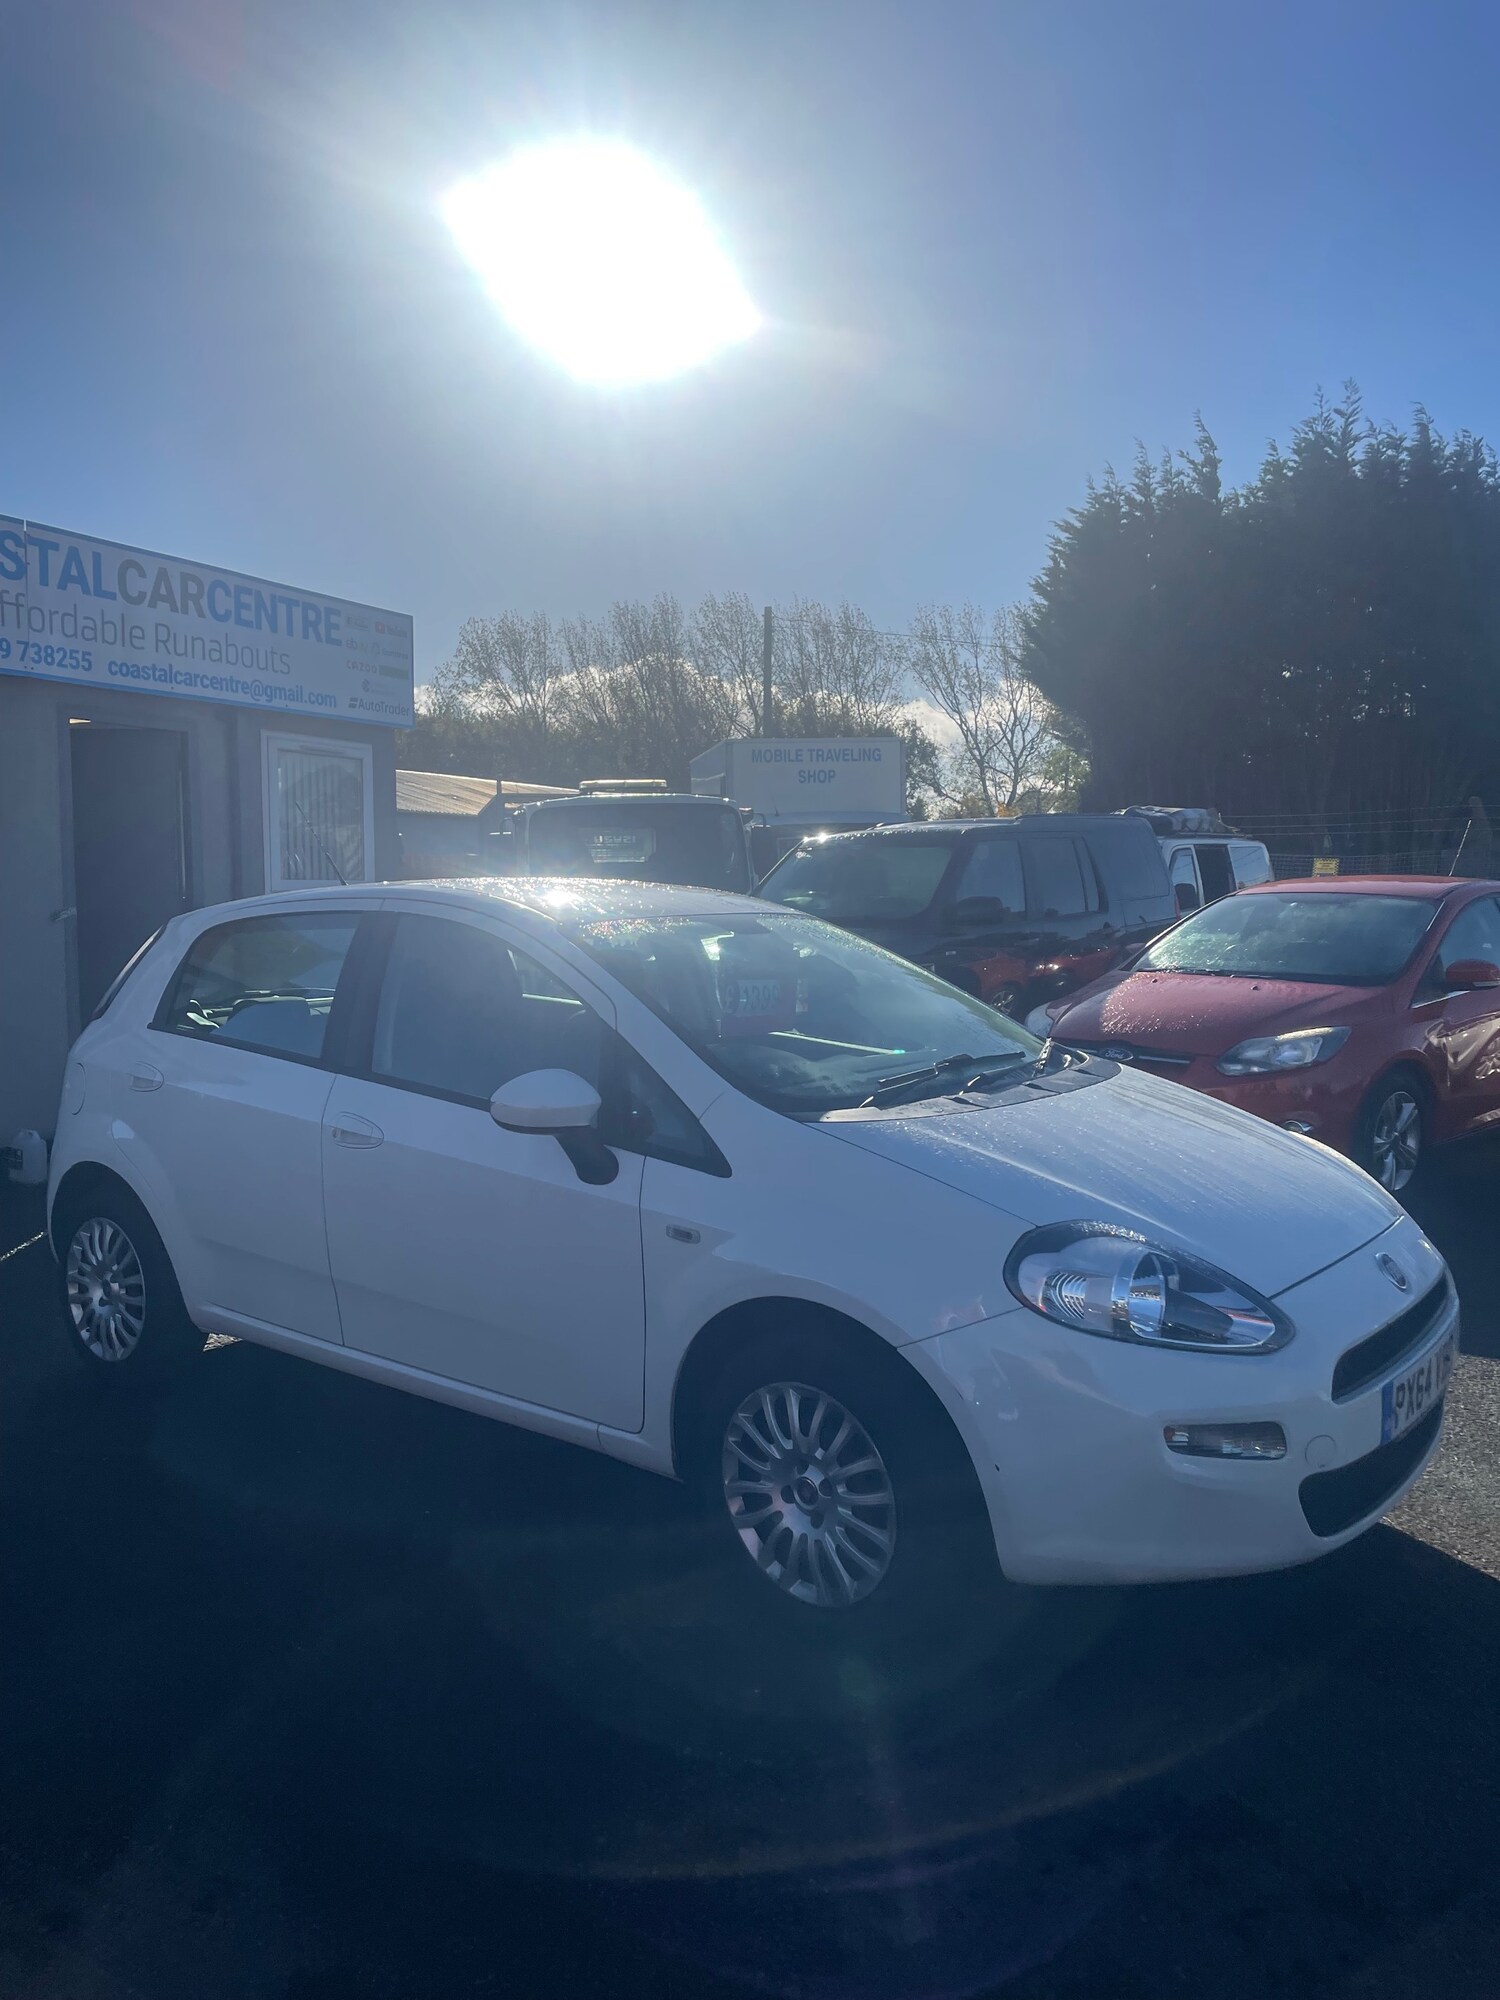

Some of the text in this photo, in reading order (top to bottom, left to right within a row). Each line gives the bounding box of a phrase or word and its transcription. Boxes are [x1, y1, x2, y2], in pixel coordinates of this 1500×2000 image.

[154, 623, 291, 675] Runabouts
[16, 640, 93, 672] 738255
[108, 660, 337, 709] coastalcarcentre@gmail.com
[358, 698, 410, 717] AutoTrader
[751, 747, 882, 763] MOBILE TRAVELING
[798, 769, 836, 784] SHOP
